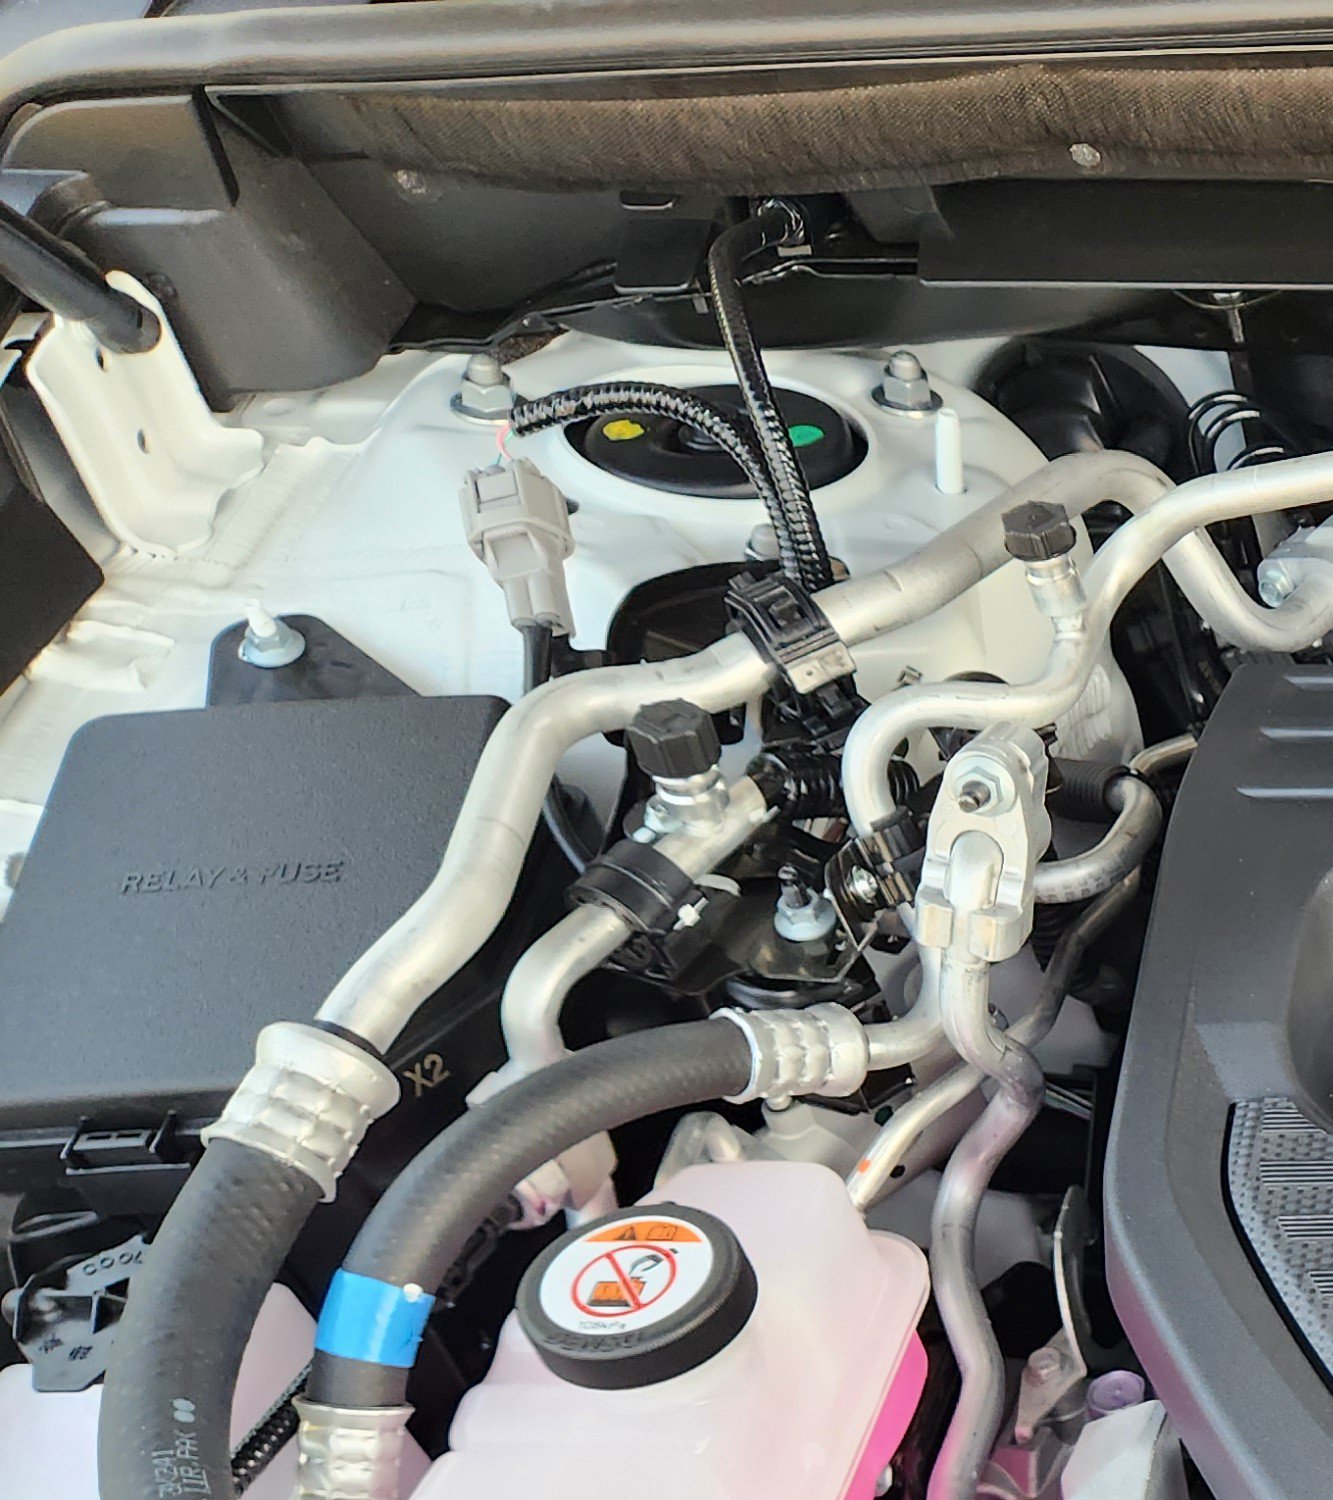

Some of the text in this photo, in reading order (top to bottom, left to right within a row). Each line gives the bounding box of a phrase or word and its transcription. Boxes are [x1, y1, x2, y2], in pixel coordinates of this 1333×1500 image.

[121, 866, 227, 895] RELAY
[260, 859, 346, 886] FUSE
[403, 1052, 451, 1097] X2
